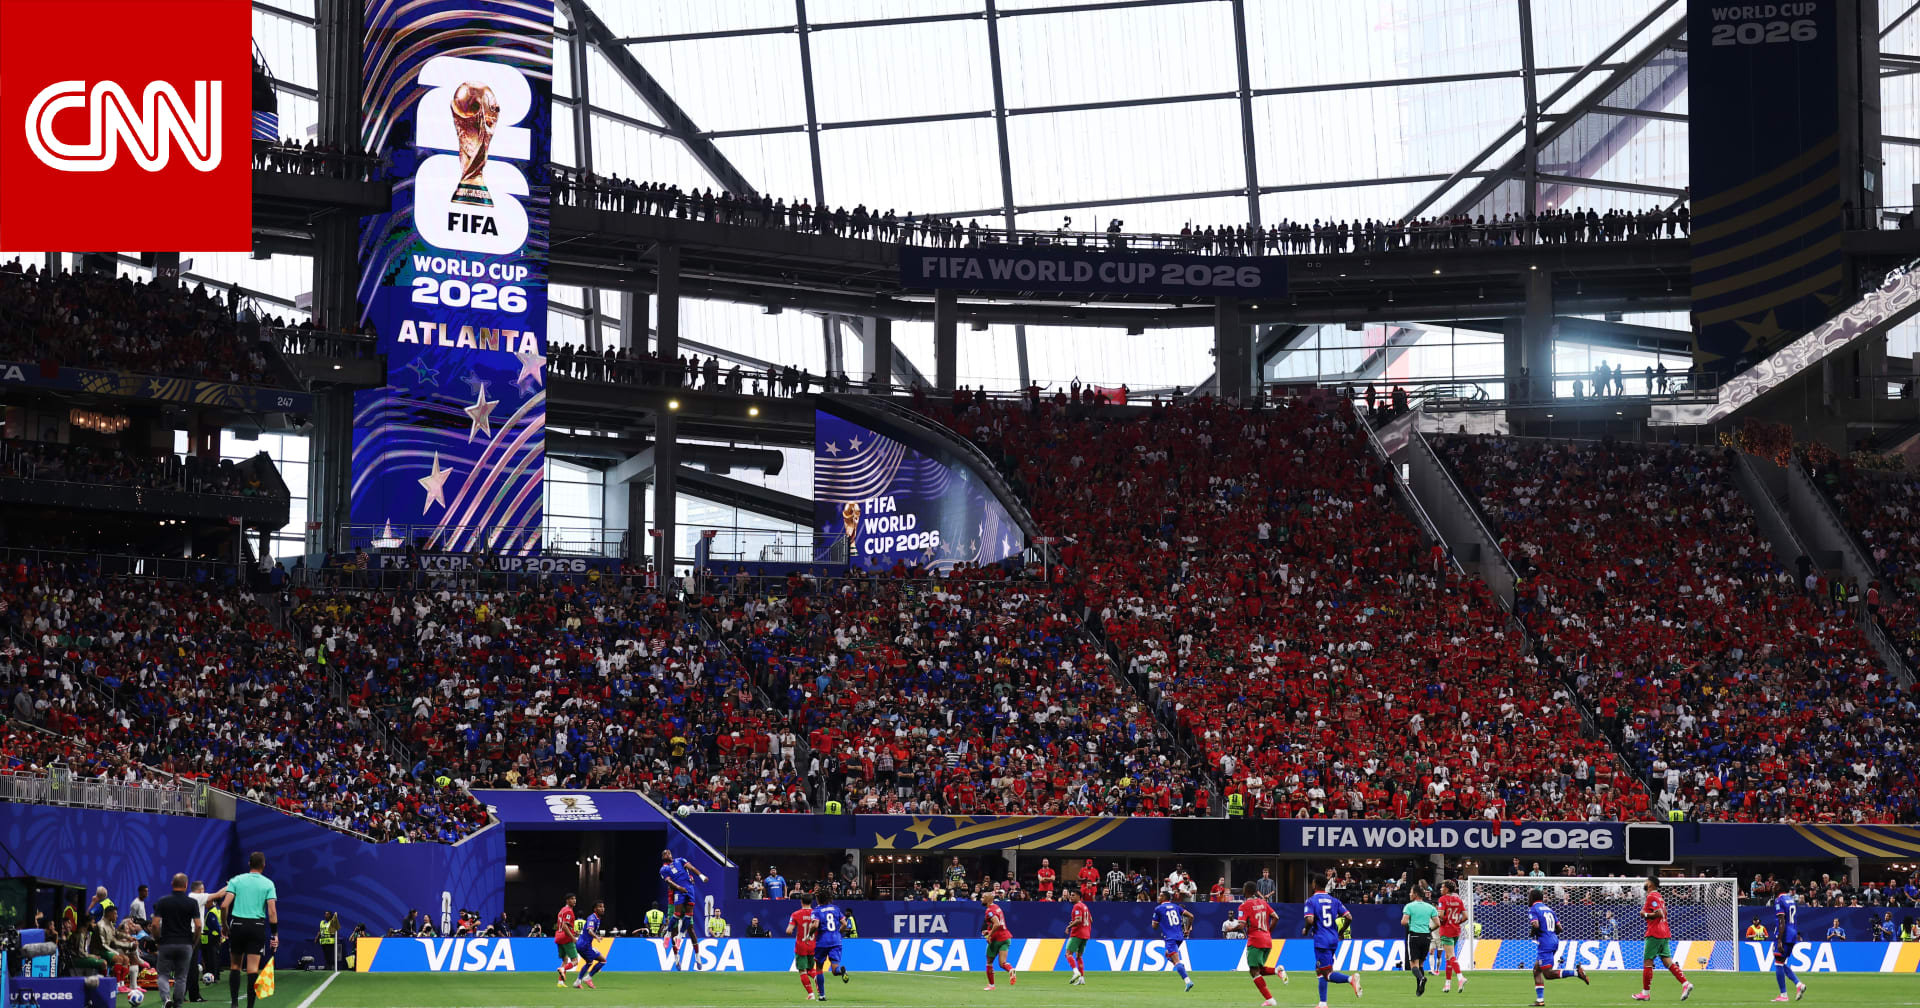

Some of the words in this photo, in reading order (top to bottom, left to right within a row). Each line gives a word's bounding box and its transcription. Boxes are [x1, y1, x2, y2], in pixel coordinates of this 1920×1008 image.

[1711, 5, 1777, 21] WORLD
[1780, 2, 1817, 17] CUP
[1711, 19, 1818, 46] 2026
[447, 211, 499, 237] FIFA
[160, 267, 178, 279] 247
[412, 254, 486, 278] WORLD
[488, 262, 529, 282] CUP
[922, 256, 985, 279] FIFA
[988, 258, 1094, 283] WORLD
[1099, 261, 1157, 285] CUP
[1161, 263, 1262, 288] 2026
[411, 276, 528, 314] 2026
[397, 319, 540, 355] ATLANTA
[277, 396, 294, 407] 247
[865, 495, 897, 515] FIFA
[864, 513, 916, 535] WORLD
[864, 536, 895, 555] CUP
[896, 530, 940, 552] 2026
[525, 558, 586, 572] 2026
[1302, 826, 1359, 847] FIFA
[1362, 826, 1458, 848] WORLD
[1463, 827, 1516, 849] CUP
[1521, 828, 1613, 850] 2026
[826, 913, 836, 932] 8
[893, 914, 949, 934] FIFA
[1166, 910, 1180, 927] 18
[1322, 905, 1333, 927] 5
[1543, 911, 1556, 932] 10
[414, 937, 516, 971] VISA
[645, 938, 745, 972] VISA
[872, 938, 970, 972] VISA
[1096, 939, 1193, 972] VISA
[1744, 941, 1838, 972] VSA
[41, 992, 73, 1001] 2026
